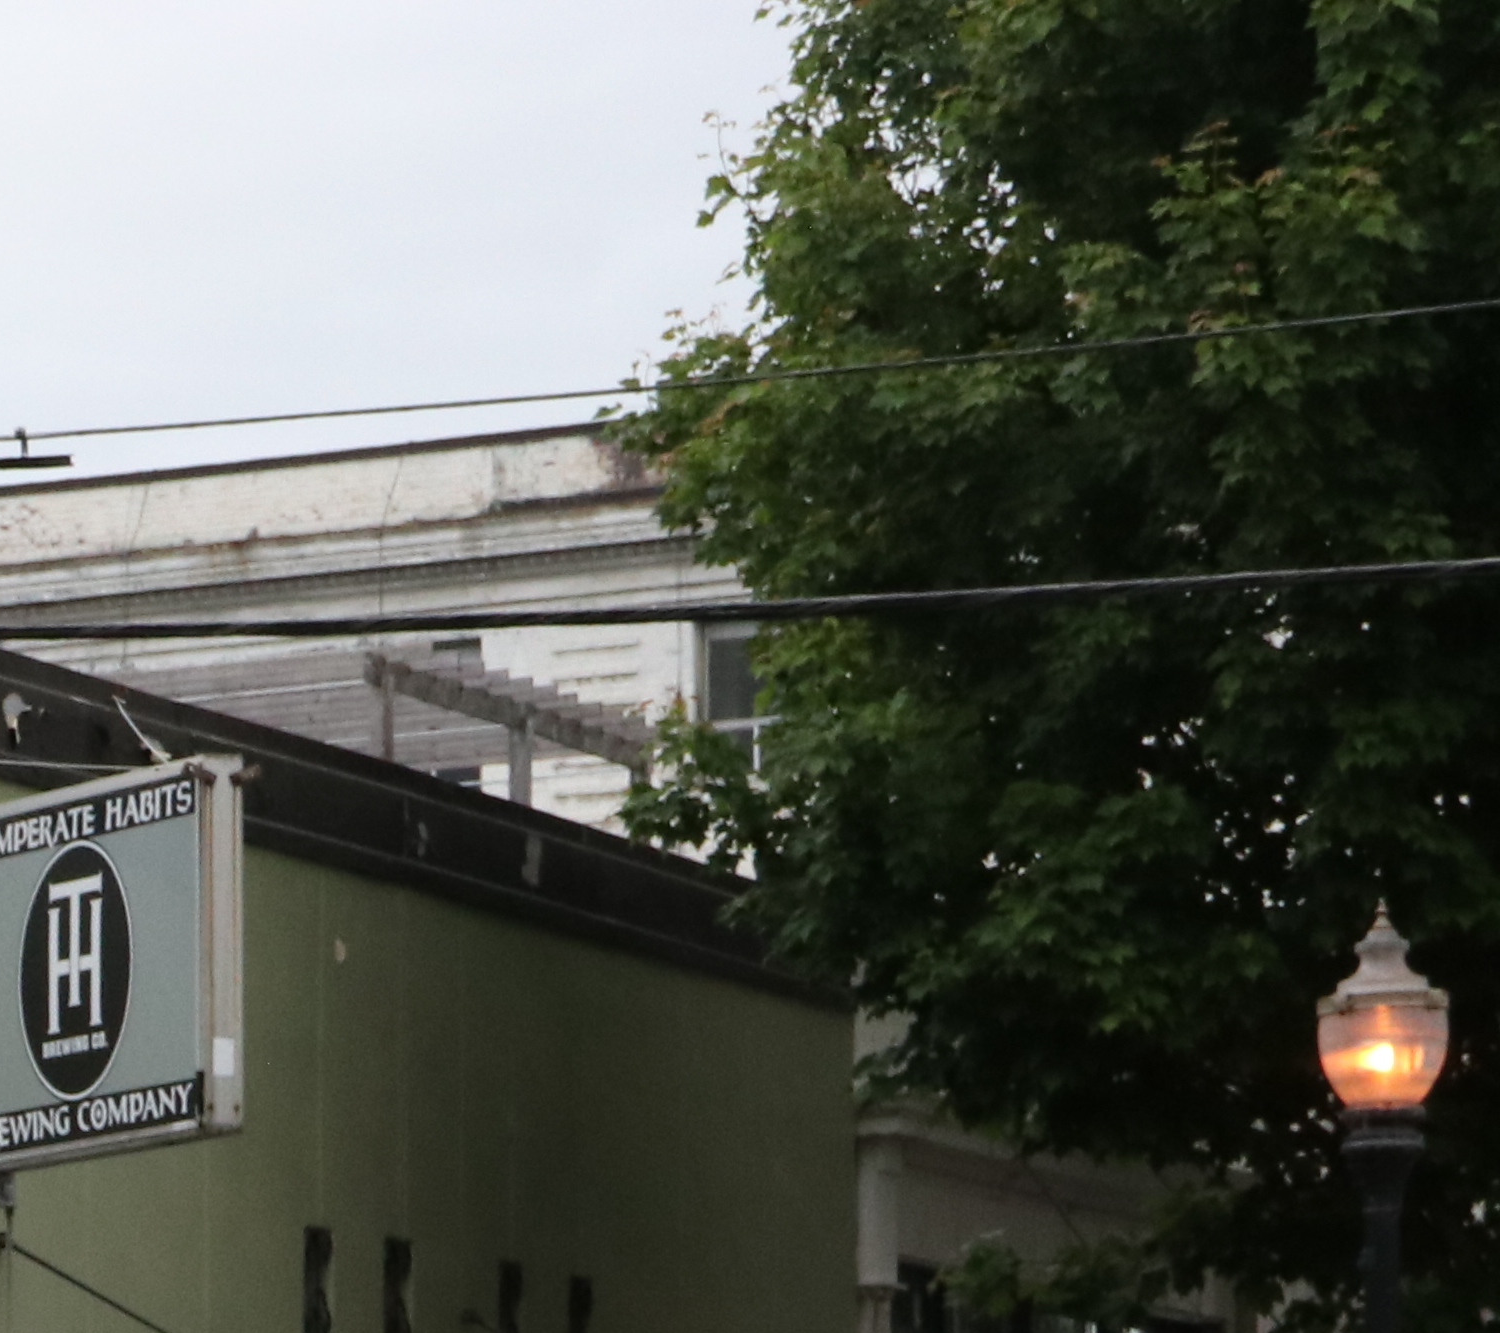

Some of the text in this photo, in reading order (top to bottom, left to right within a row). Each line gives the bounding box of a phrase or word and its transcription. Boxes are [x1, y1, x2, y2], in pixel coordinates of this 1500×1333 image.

[104, 780, 194, 830] HABITS
[41, 1034, 89, 1060] BREWING
[77, 1081, 194, 1131] COMPANY
